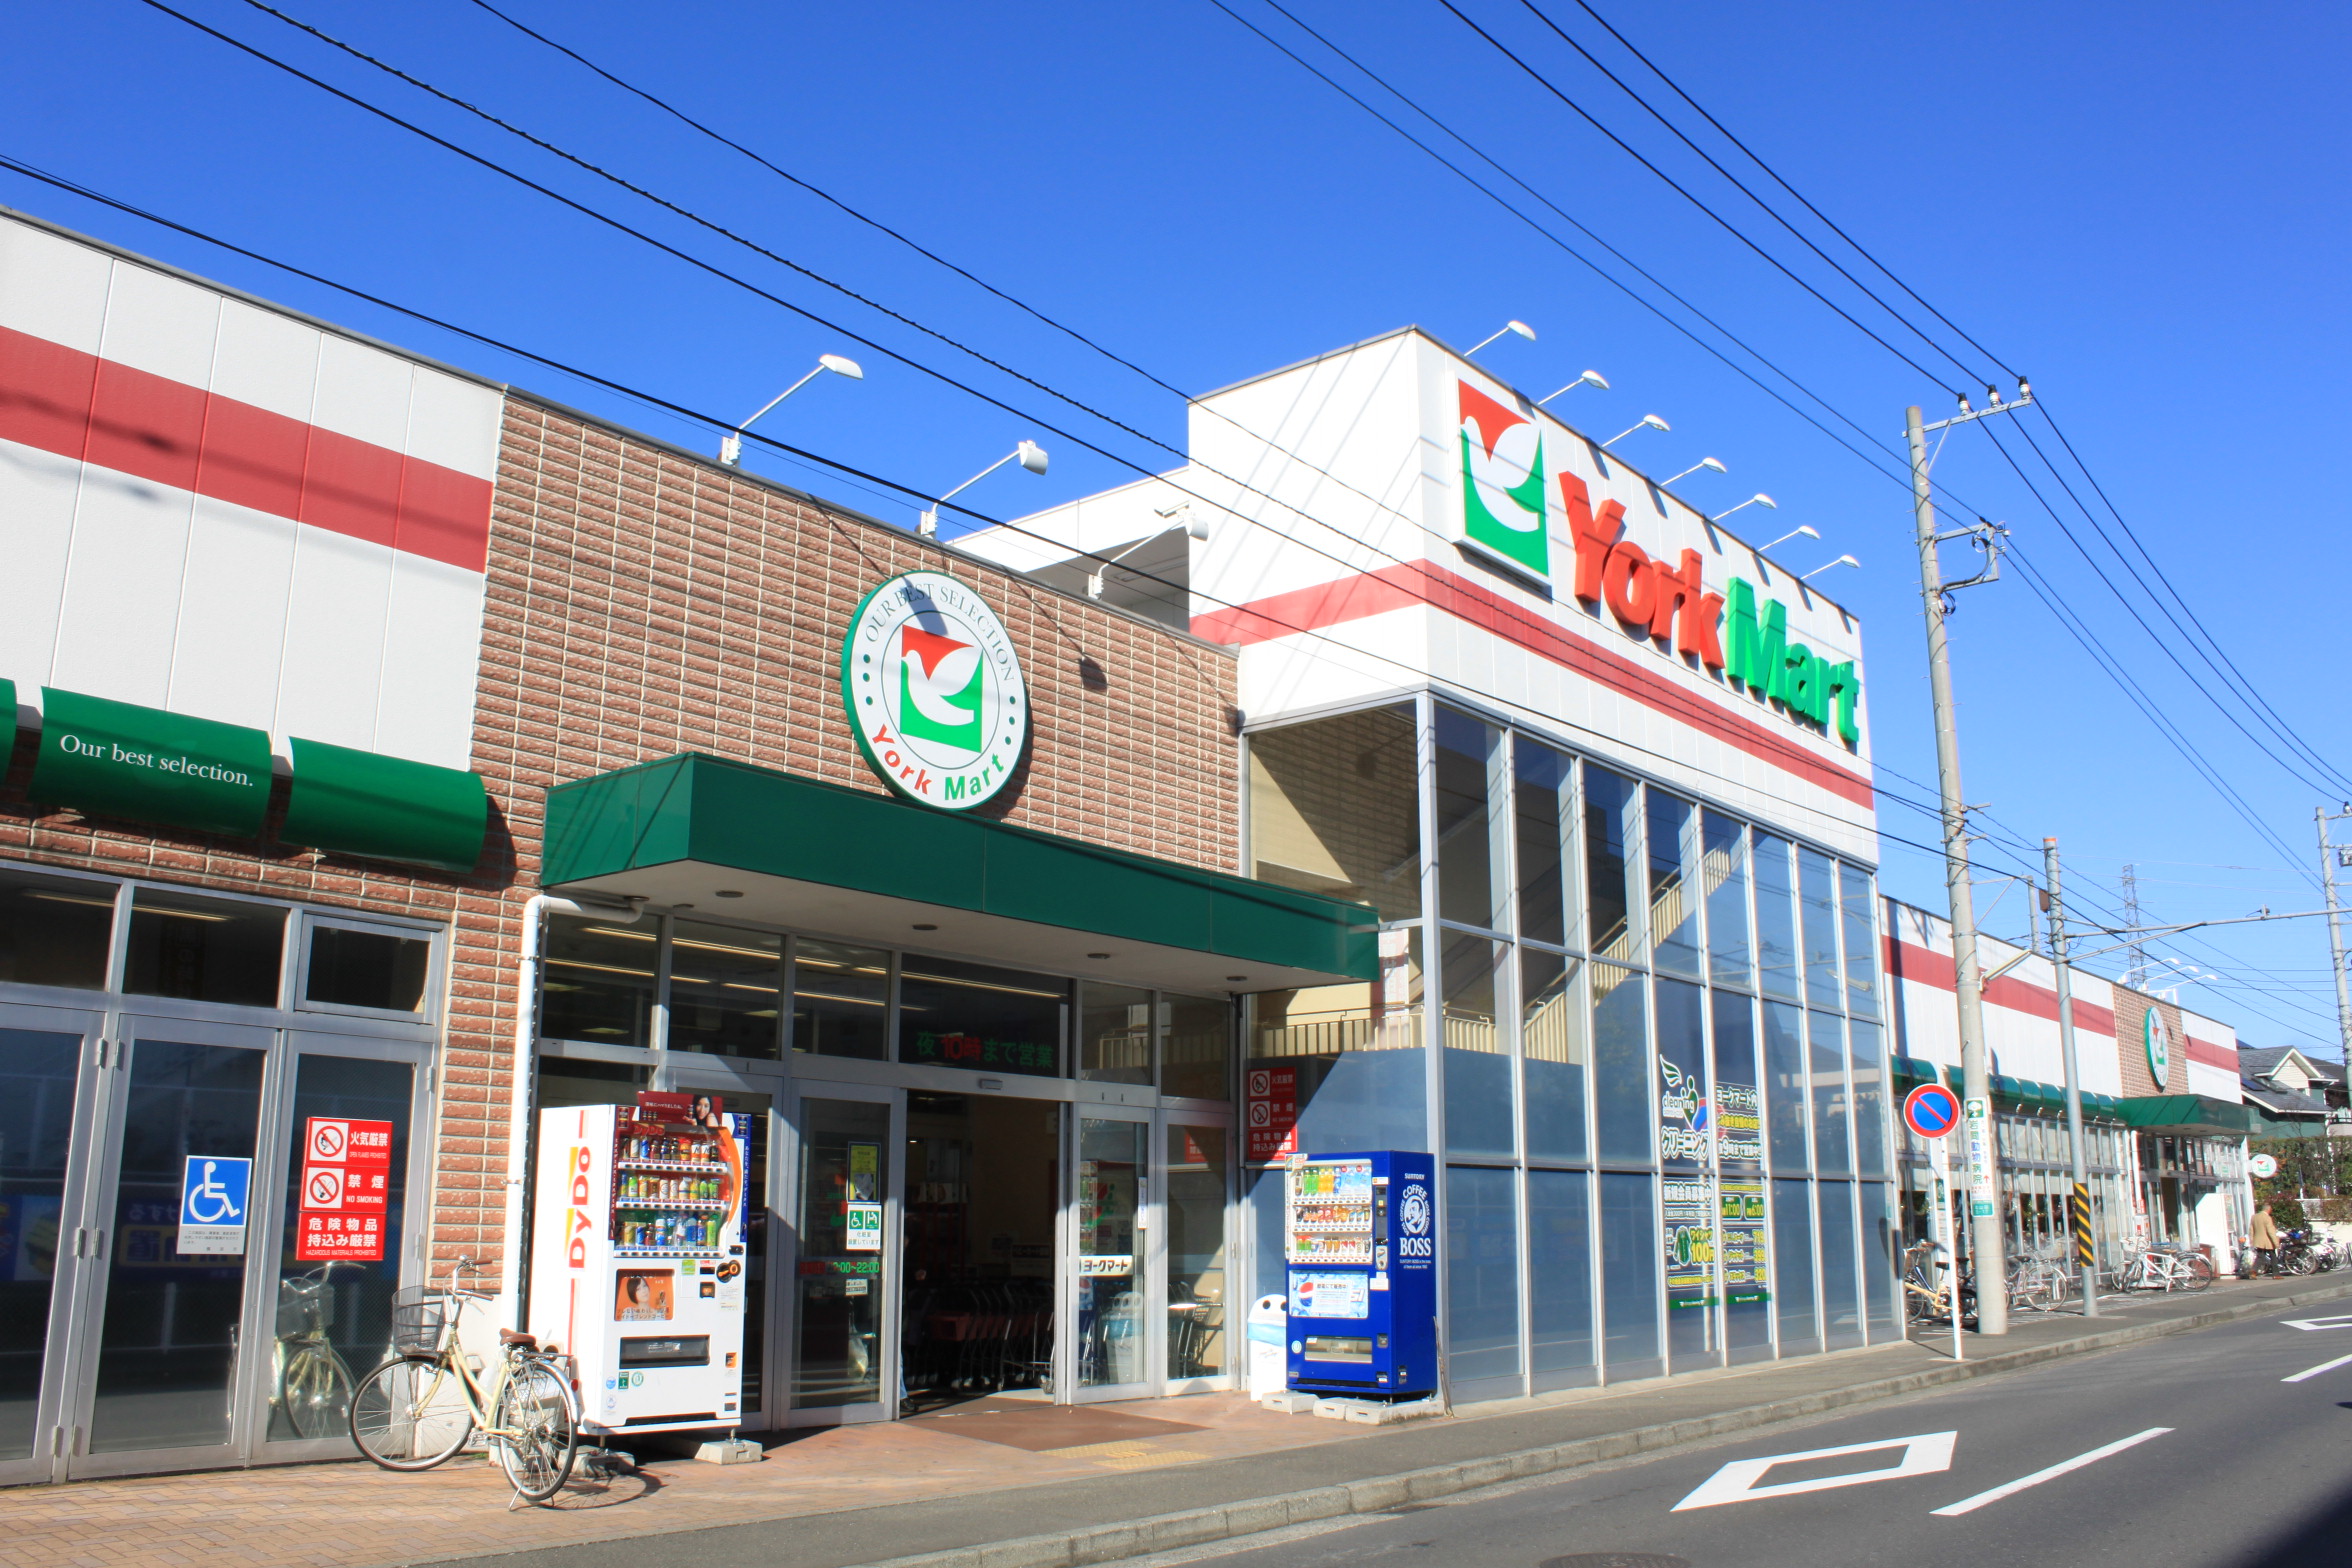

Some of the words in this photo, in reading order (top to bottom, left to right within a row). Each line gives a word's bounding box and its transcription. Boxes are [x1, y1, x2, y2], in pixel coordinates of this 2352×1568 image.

[1559, 471, 1725, 669] York
[1727, 577, 1859, 742] Mart
[865, 600, 896, 643] OUR
[895, 584, 934, 605] BEST
[940, 587, 1014, 681] SELECTION
[59, 734, 106, 759] Our
[112, 743, 154, 769] best
[159, 754, 254, 787] selection.
[872, 724, 932, 795] York
[944, 753, 1004, 801] Mart
[1662, 1091, 1695, 1113] cleaning
[350, 1131, 388, 1147] 火気厳禁
[1662, 1129, 1709, 1158] クリーニング
[348, 1174, 385, 1189] 禁煙
[346, 1195, 355, 1203] NO
[356, 1196, 383, 1204] SMOKING
[1403, 1184, 1428, 1199] COFFEE
[308, 1217, 378, 1232] 危険物品
[307, 1233, 377, 1248] 持込み厳禁
[1400, 1238, 1431, 1256] BOSS
[1083, 1259, 1128, 1272] ヨークマート
